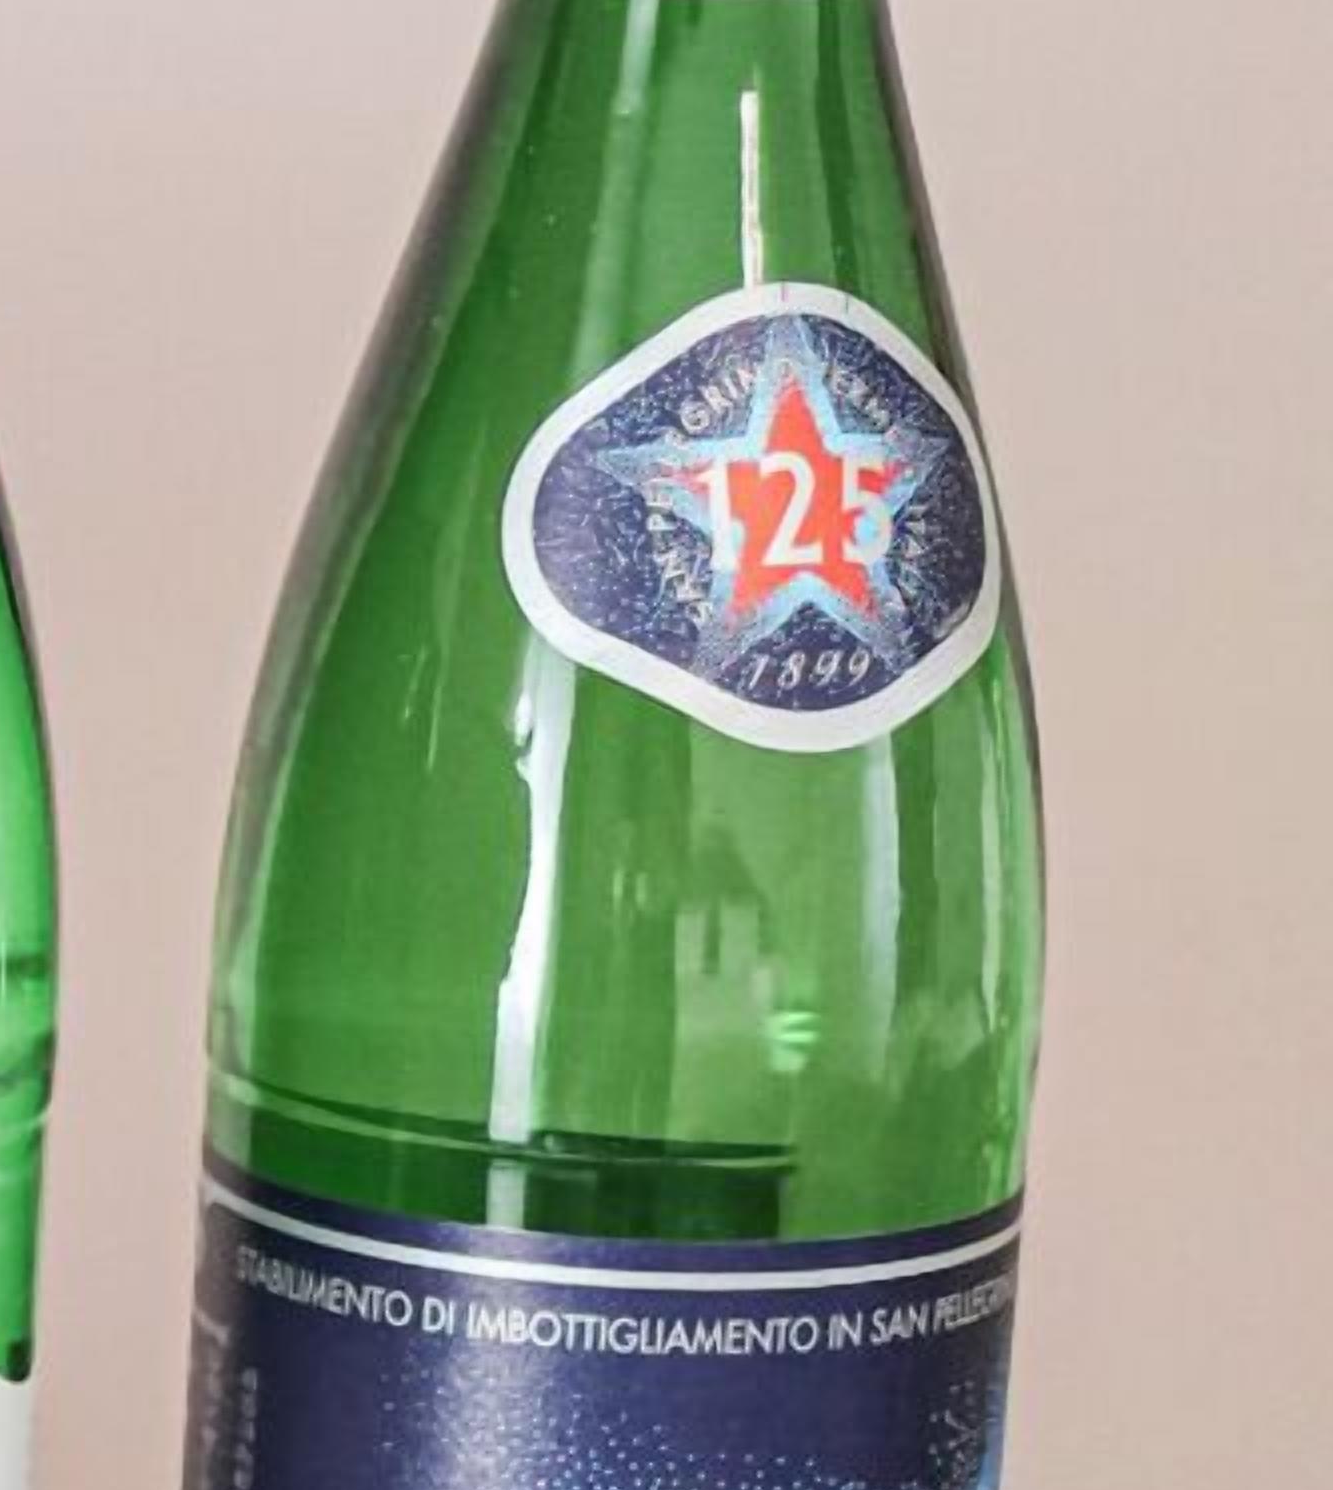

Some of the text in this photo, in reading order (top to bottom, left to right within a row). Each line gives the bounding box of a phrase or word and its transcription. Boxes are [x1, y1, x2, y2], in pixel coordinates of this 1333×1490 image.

[695, 450, 895, 572] 125
[745, 648, 871, 691] 1899
[421, 1296, 455, 1336] DI
[465, 1300, 820, 1355] IMBOTTIGLIAMENTO
[827, 1310, 863, 1351] IN
[869, 1300, 930, 1347] SAN
